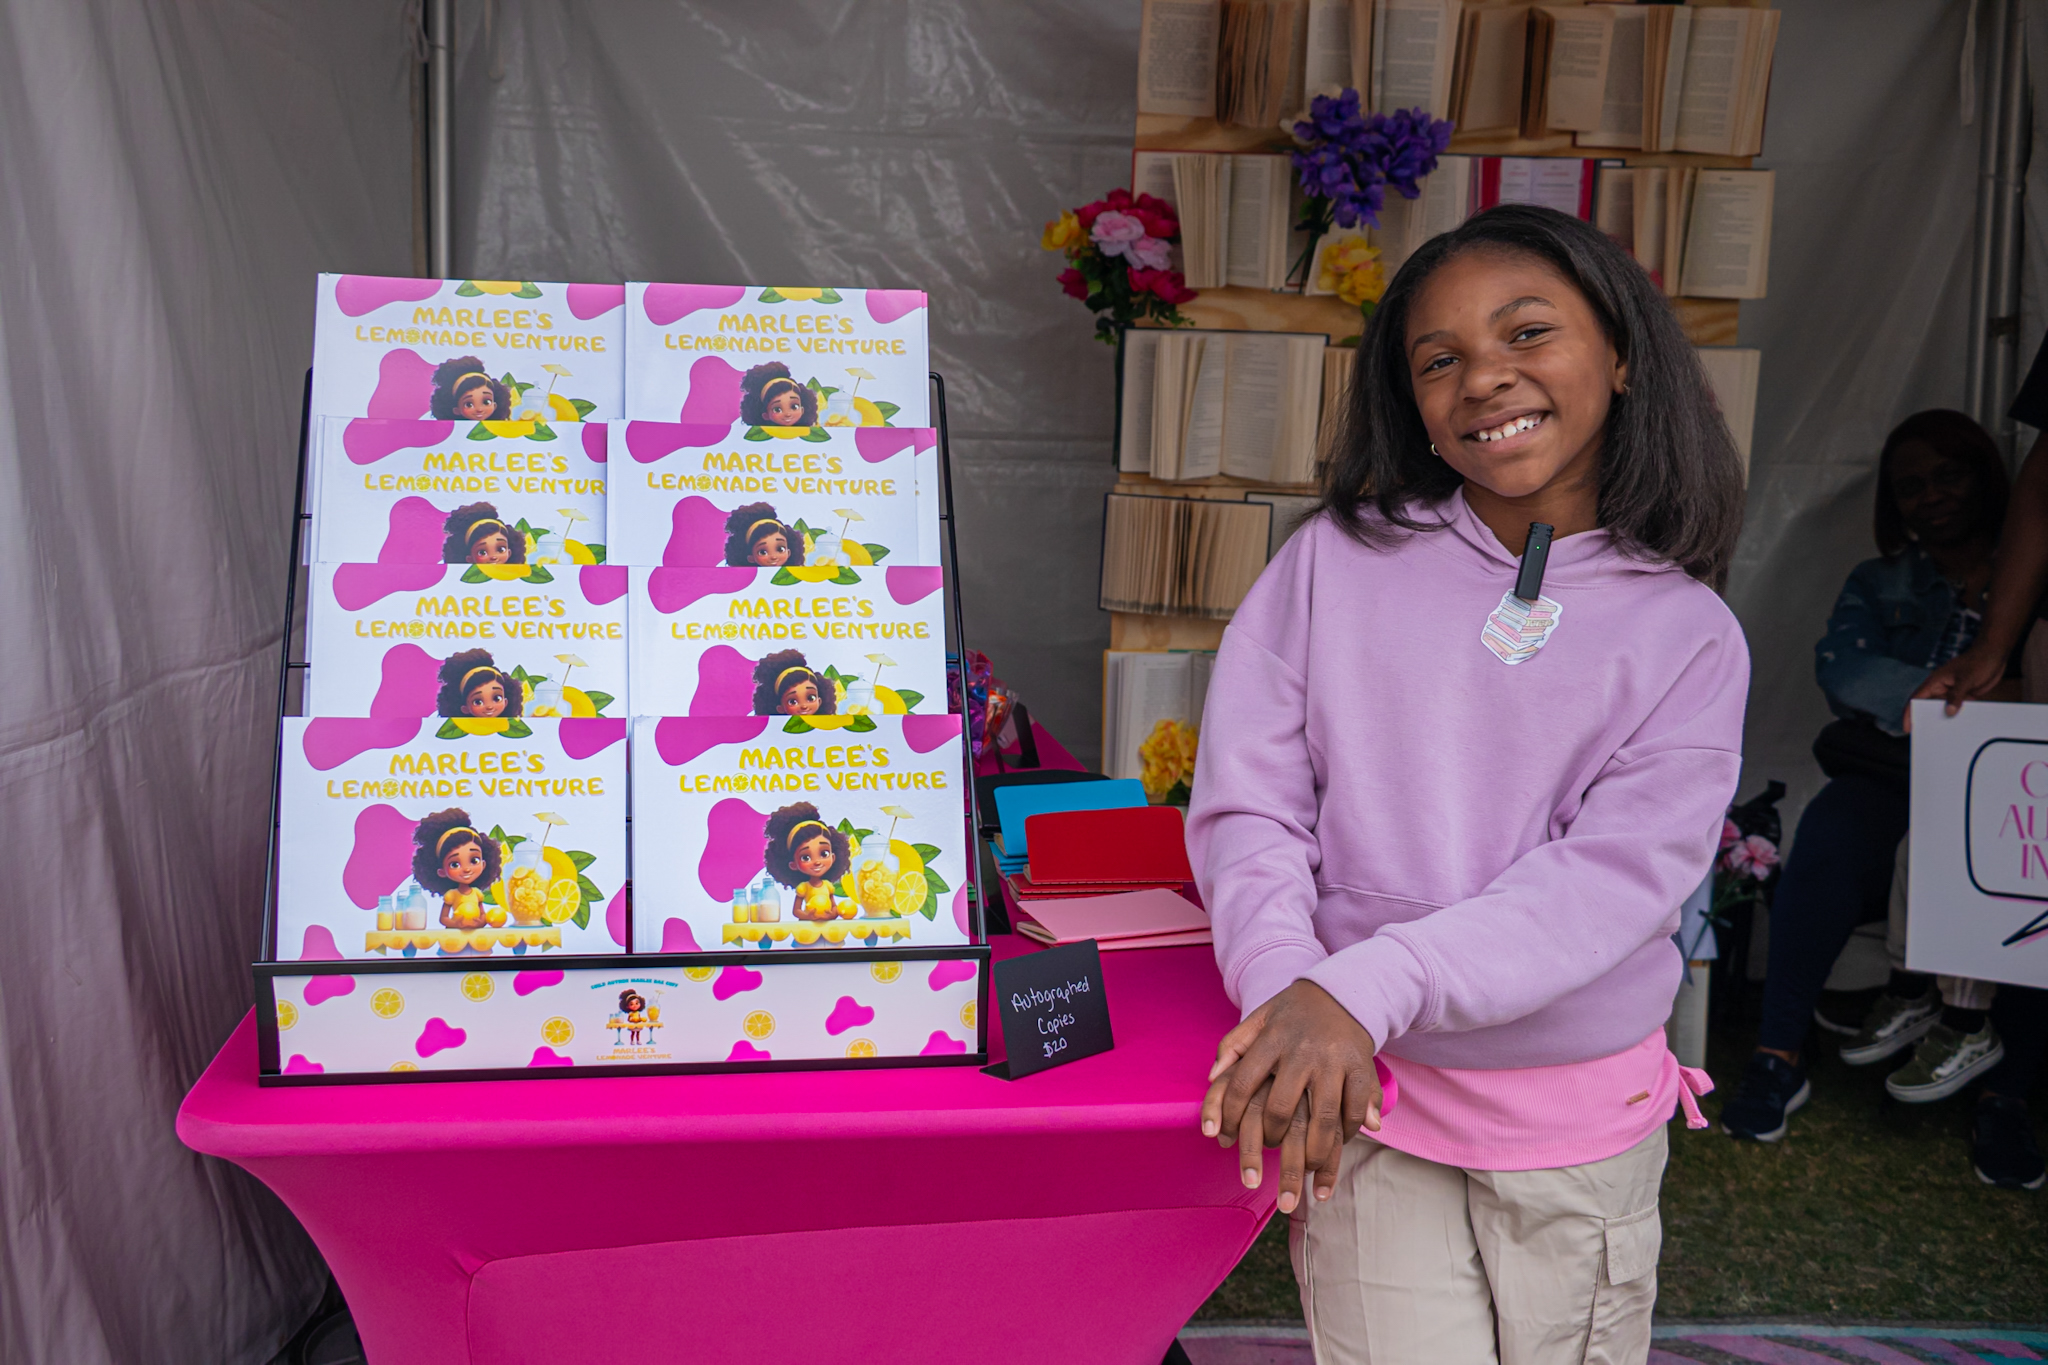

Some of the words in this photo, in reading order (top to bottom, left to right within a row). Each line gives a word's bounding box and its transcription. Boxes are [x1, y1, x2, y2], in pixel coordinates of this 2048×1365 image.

[413, 307, 551, 329] MARLEE'S
[718, 314, 853, 333] MARLEE'S
[356, 326, 485, 346] LEMONADE
[493, 333, 605, 351] VENTURE
[665, 334, 790, 352] LEMONADE
[797, 338, 905, 354] VENTURE
[423, 452, 567, 473] MARLEE'S
[703, 452, 842, 473] MARLEE'S
[365, 474, 499, 492] LEMONADE
[648, 472, 776, 492] LEMONADE
[783, 478, 895, 495] VENTURE
[416, 596, 564, 617] MARLEE'S
[729, 596, 873, 618] MARLEE'S
[355, 620, 494, 638] LEMONADE
[502, 621, 621, 639] VENTURE
[672, 622, 806, 639] LEMONADE
[813, 622, 928, 639] VENTURE
[390, 750, 544, 774] MARLEE'S
[739, 745, 889, 769] MARLEE'S
[327, 779, 471, 798] LEMONADE
[479, 777, 603, 796] VENTURE
[680, 773, 819, 792] LEMONADE
[826, 771, 946, 790] VENTURE
[1011, 976, 1090, 1012] Autographed
[1037, 1012, 1075, 1034] Copies
[1043, 1037, 1067, 1058] $20
